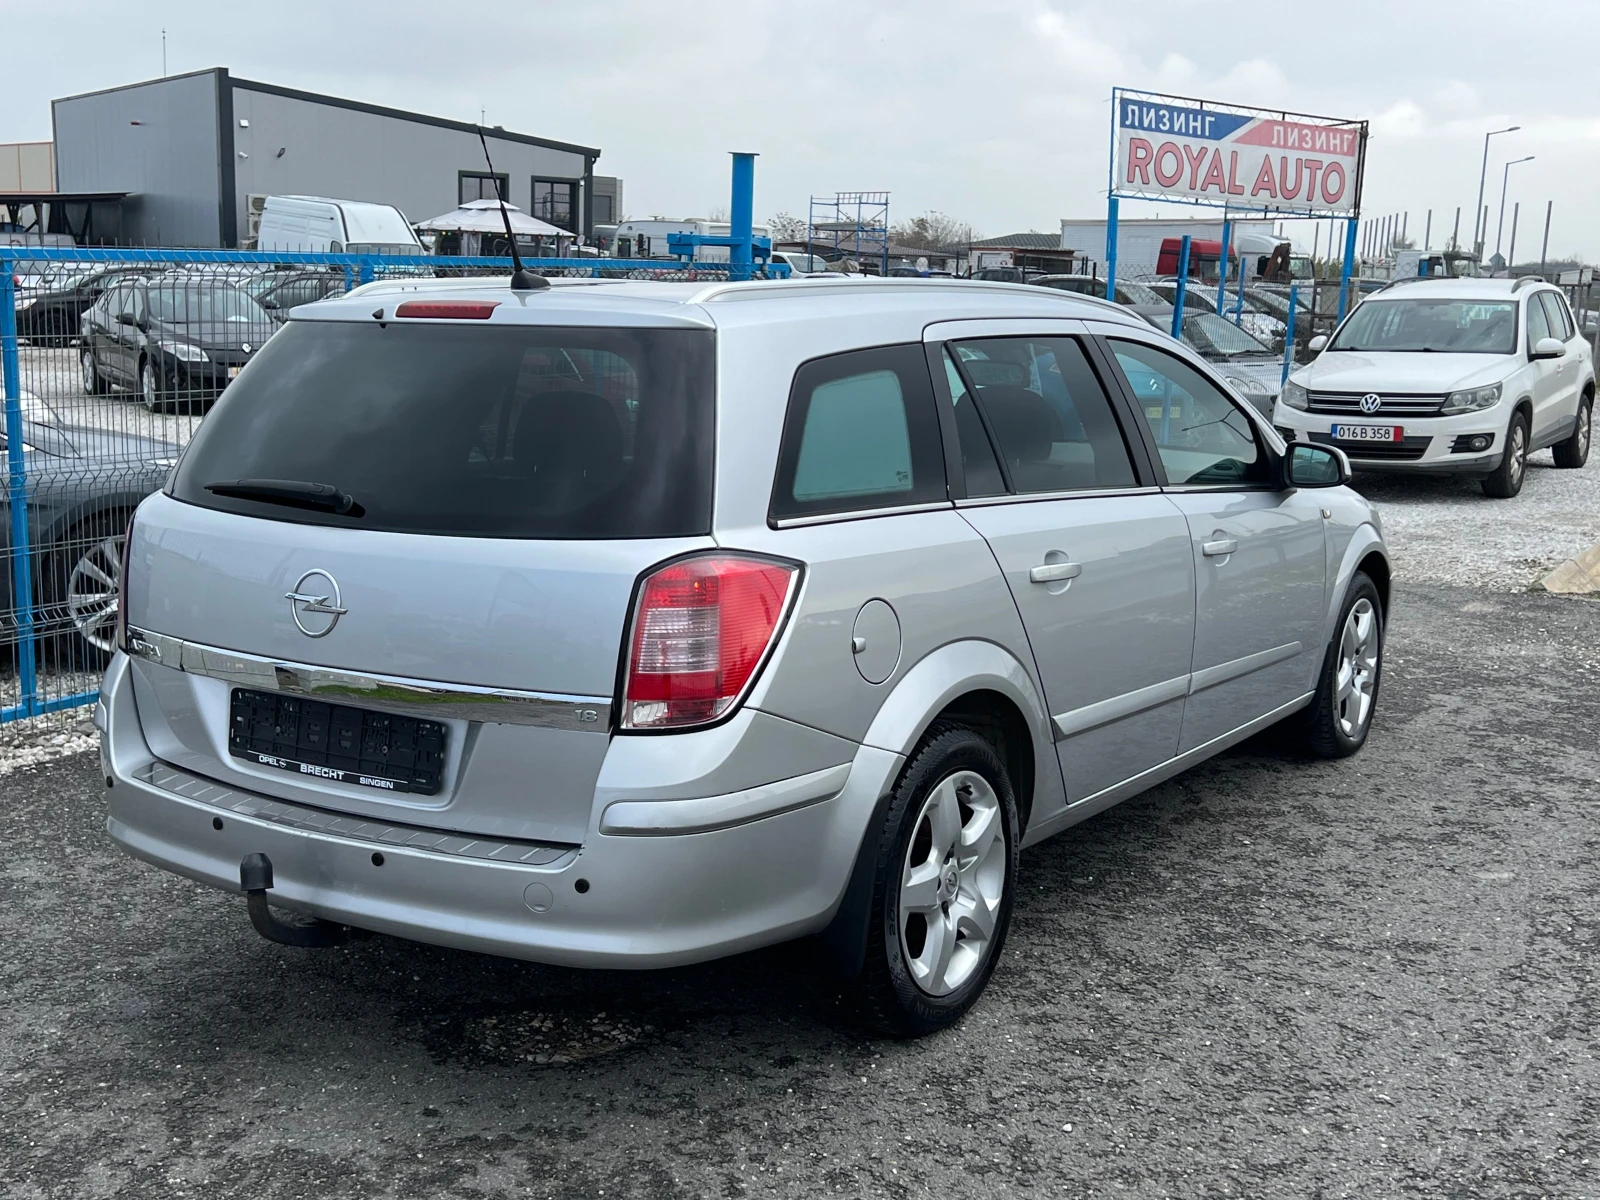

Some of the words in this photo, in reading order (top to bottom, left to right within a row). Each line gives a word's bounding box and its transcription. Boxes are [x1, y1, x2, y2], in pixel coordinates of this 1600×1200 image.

[1125, 104, 1216, 137] ЛИЗИНГ
[1271, 125, 1354, 153] ЛИЗИНГ
[1126, 137, 1245, 196] ROYAL
[1250, 153, 1346, 204] AUTO
[1338, 426, 1359, 438] 016
[1360, 427, 1368, 439] B
[1369, 428, 1391, 440] 358
[258, 755, 279, 766] OPEL
[300, 763, 345, 780] BRECHT
[359, 776, 394, 789] SINGEN
